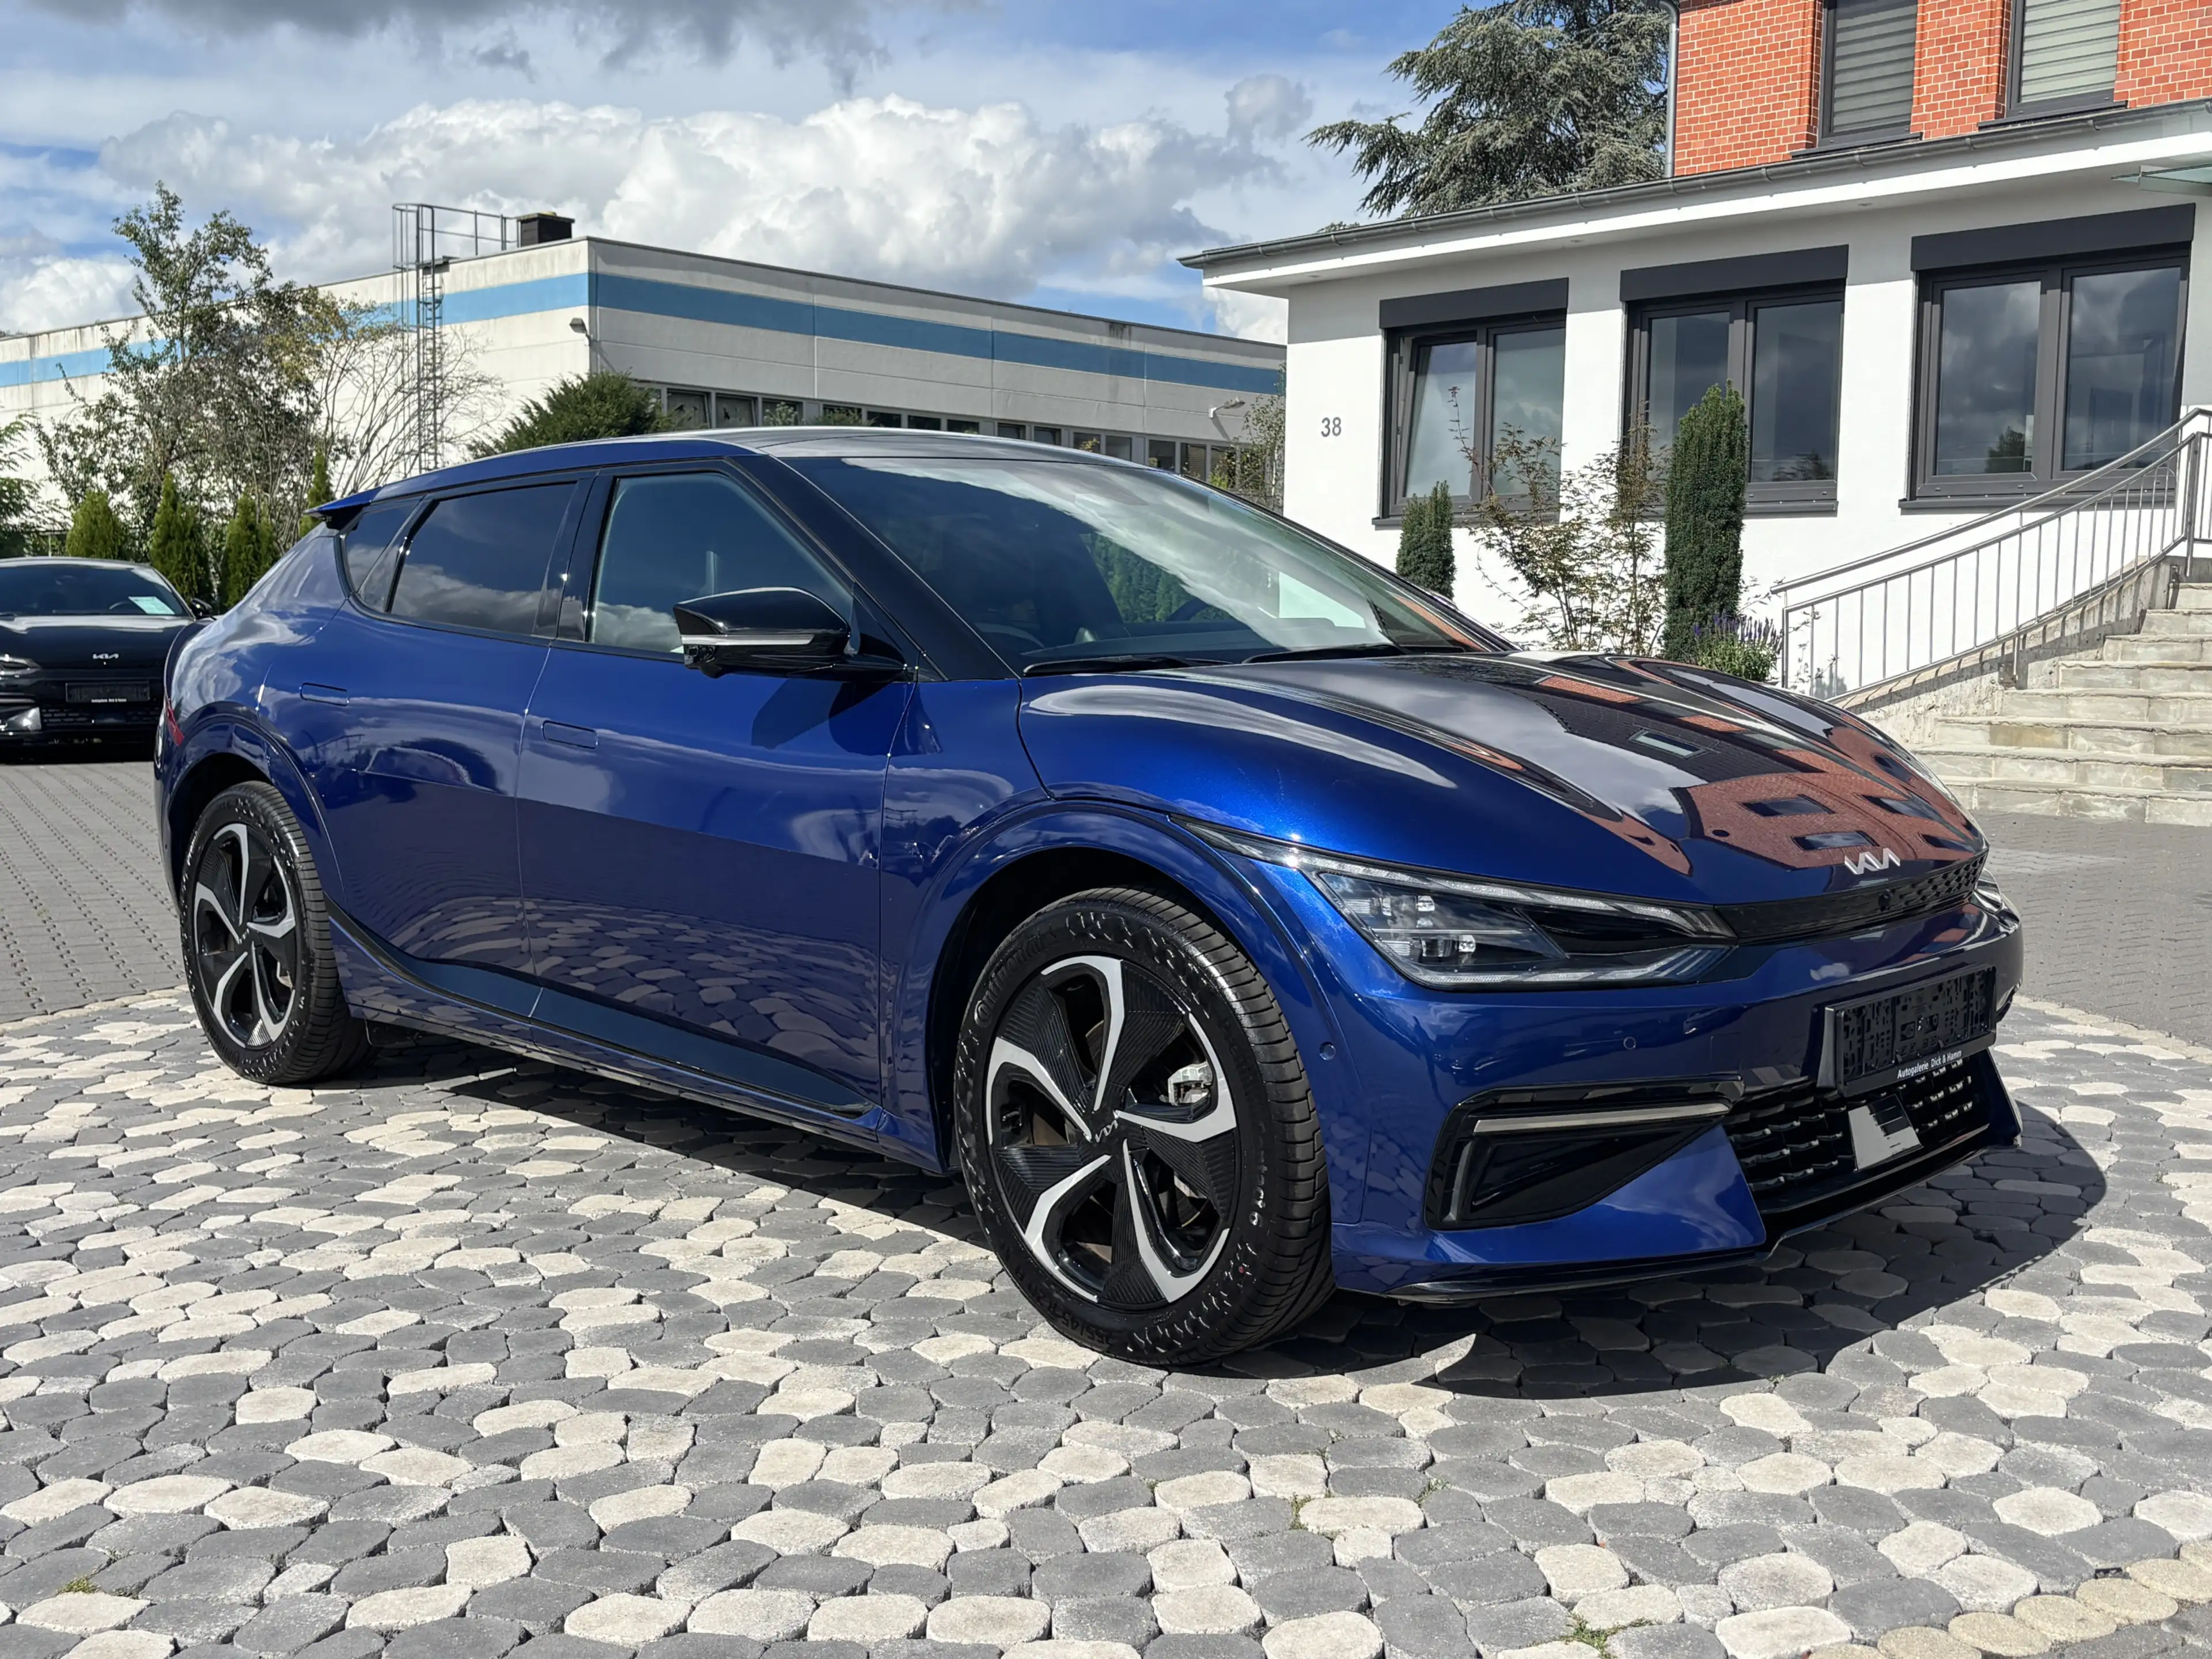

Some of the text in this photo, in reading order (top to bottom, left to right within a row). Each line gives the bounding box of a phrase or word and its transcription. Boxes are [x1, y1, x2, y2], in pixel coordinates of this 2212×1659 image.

[1321, 416, 1342, 437] 38
[1844, 847, 1900, 874] KIA
[1897, 1061, 1929, 1079] Autogalerie
[1931, 1055, 1941, 1068] Dick
[1942, 1054, 1946, 1063] &
